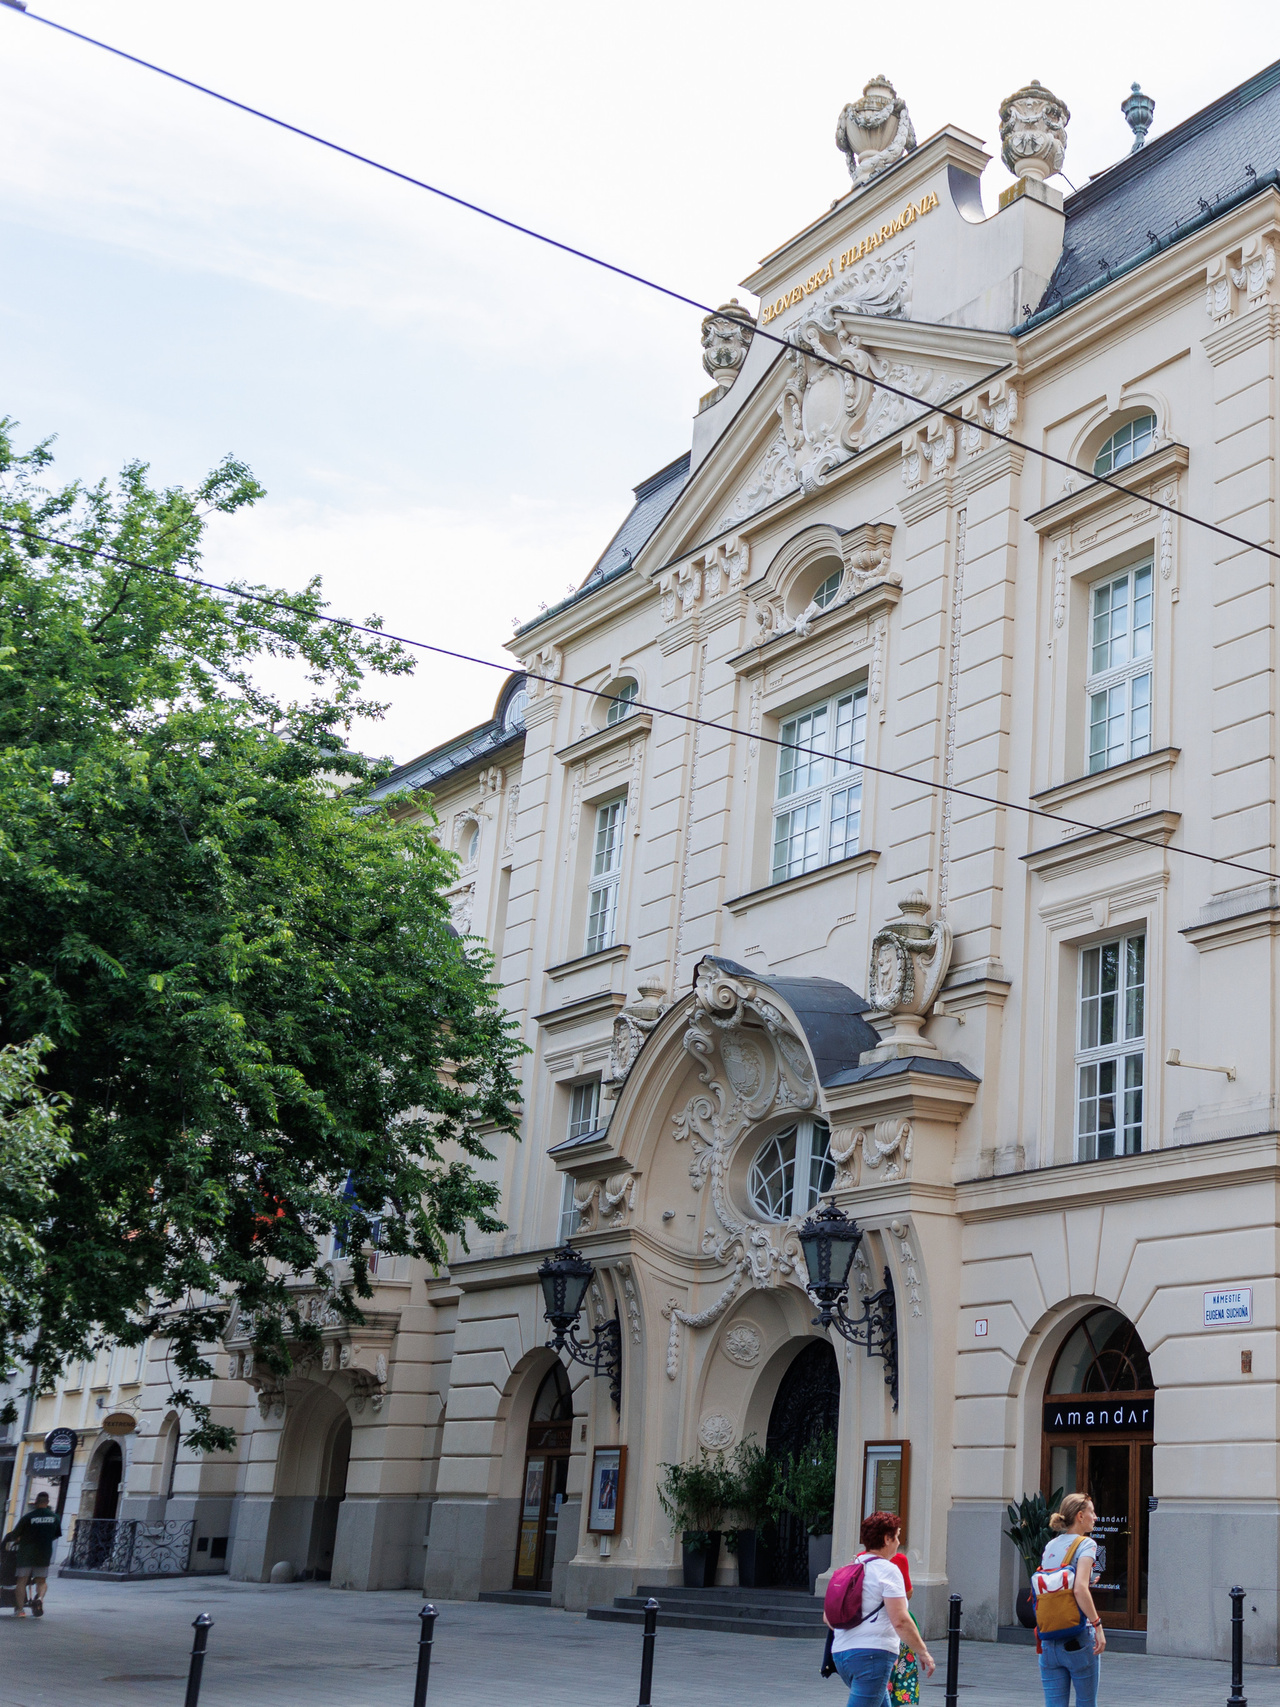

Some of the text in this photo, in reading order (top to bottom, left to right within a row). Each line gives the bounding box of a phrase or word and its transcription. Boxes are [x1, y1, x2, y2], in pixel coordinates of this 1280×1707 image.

[761, 190, 940, 326] SLOVENSKÁ FILHARMÓNIA
[1213, 1294, 1241, 1304] NÁMESTIE
[1206, 1305, 1248, 1320] EUGENA SUCHOŇA
